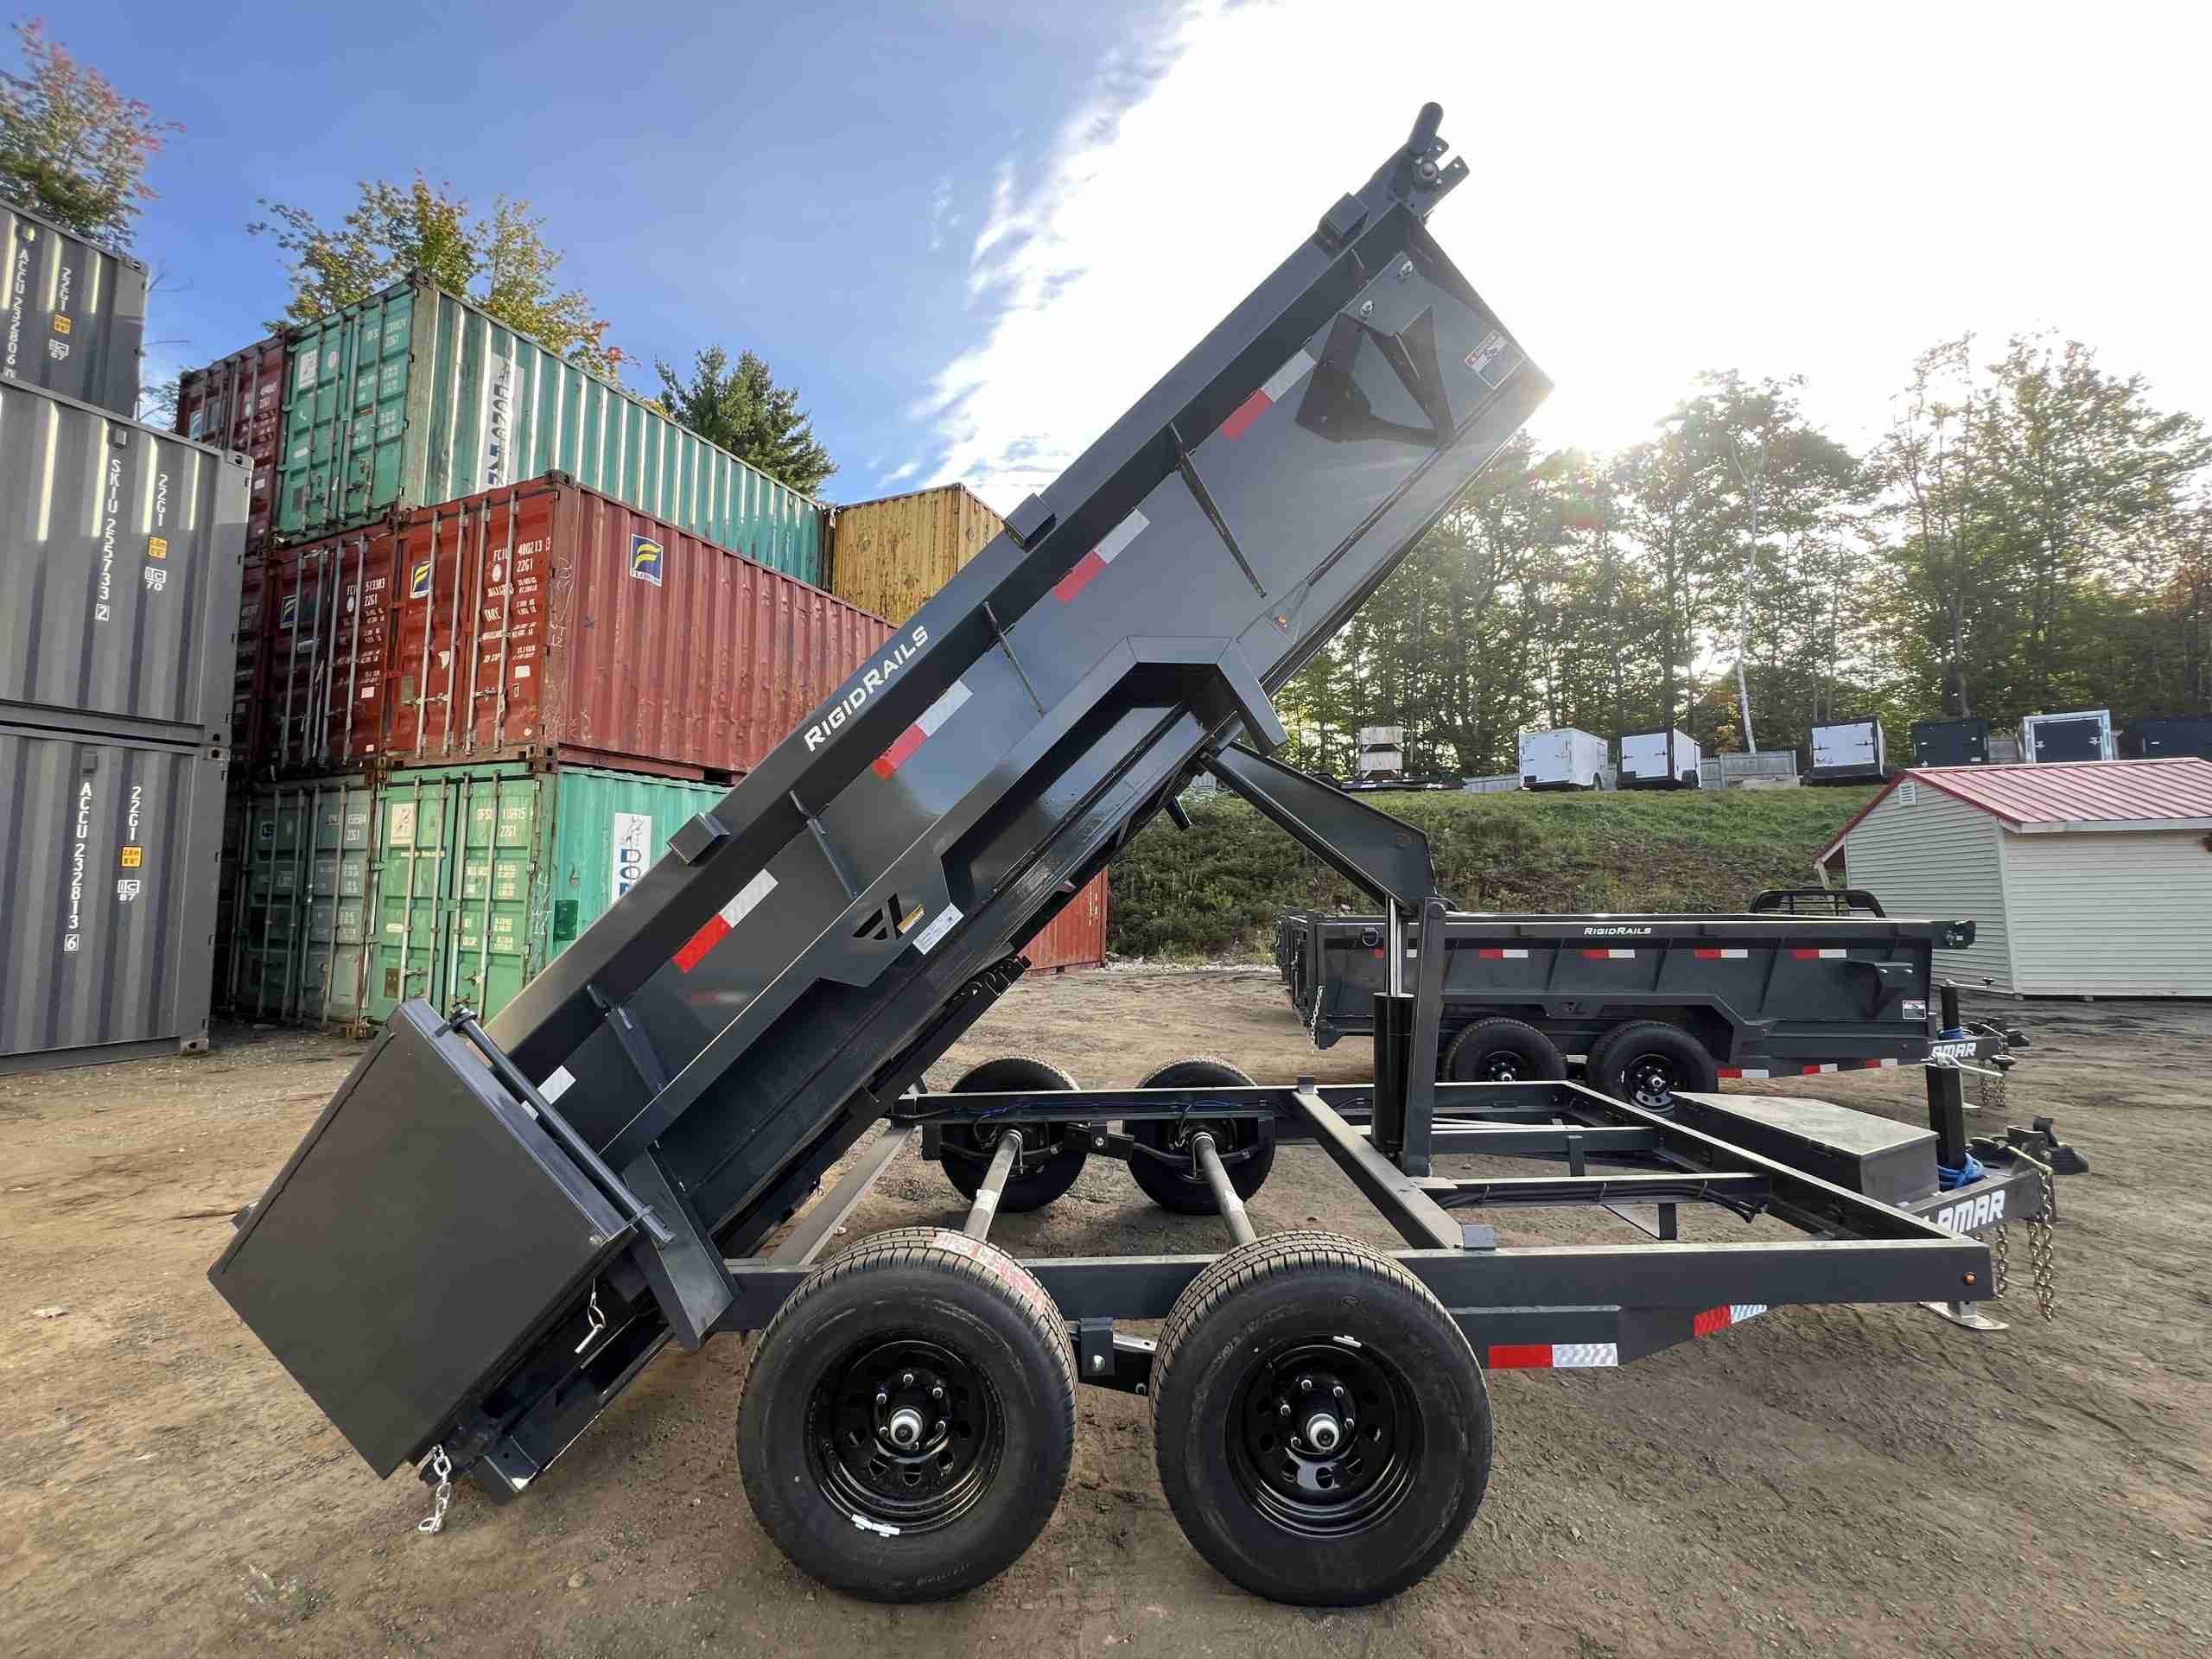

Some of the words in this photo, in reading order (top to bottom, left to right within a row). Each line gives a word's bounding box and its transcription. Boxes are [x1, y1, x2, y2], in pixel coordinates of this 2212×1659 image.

[16, 249, 29, 295] ACCU
[107, 459, 121, 514] SKIU
[156, 474, 168, 527] 22G1
[99, 518, 117, 601] 255733
[145, 580, 163, 592] 70
[95, 604, 111, 621] 2
[804, 626, 929, 752] RIGIDRAILS
[76, 782, 92, 838] ACCU
[129, 786, 142, 841] 22G1
[68, 843, 85, 930] 232813
[64, 934, 79, 951] 6
[1584, 927, 1652, 936] RIGIDRAILS
[1929, 1042, 1976, 1061] AMAR
[1937, 1189, 2005, 1233] AMAR
